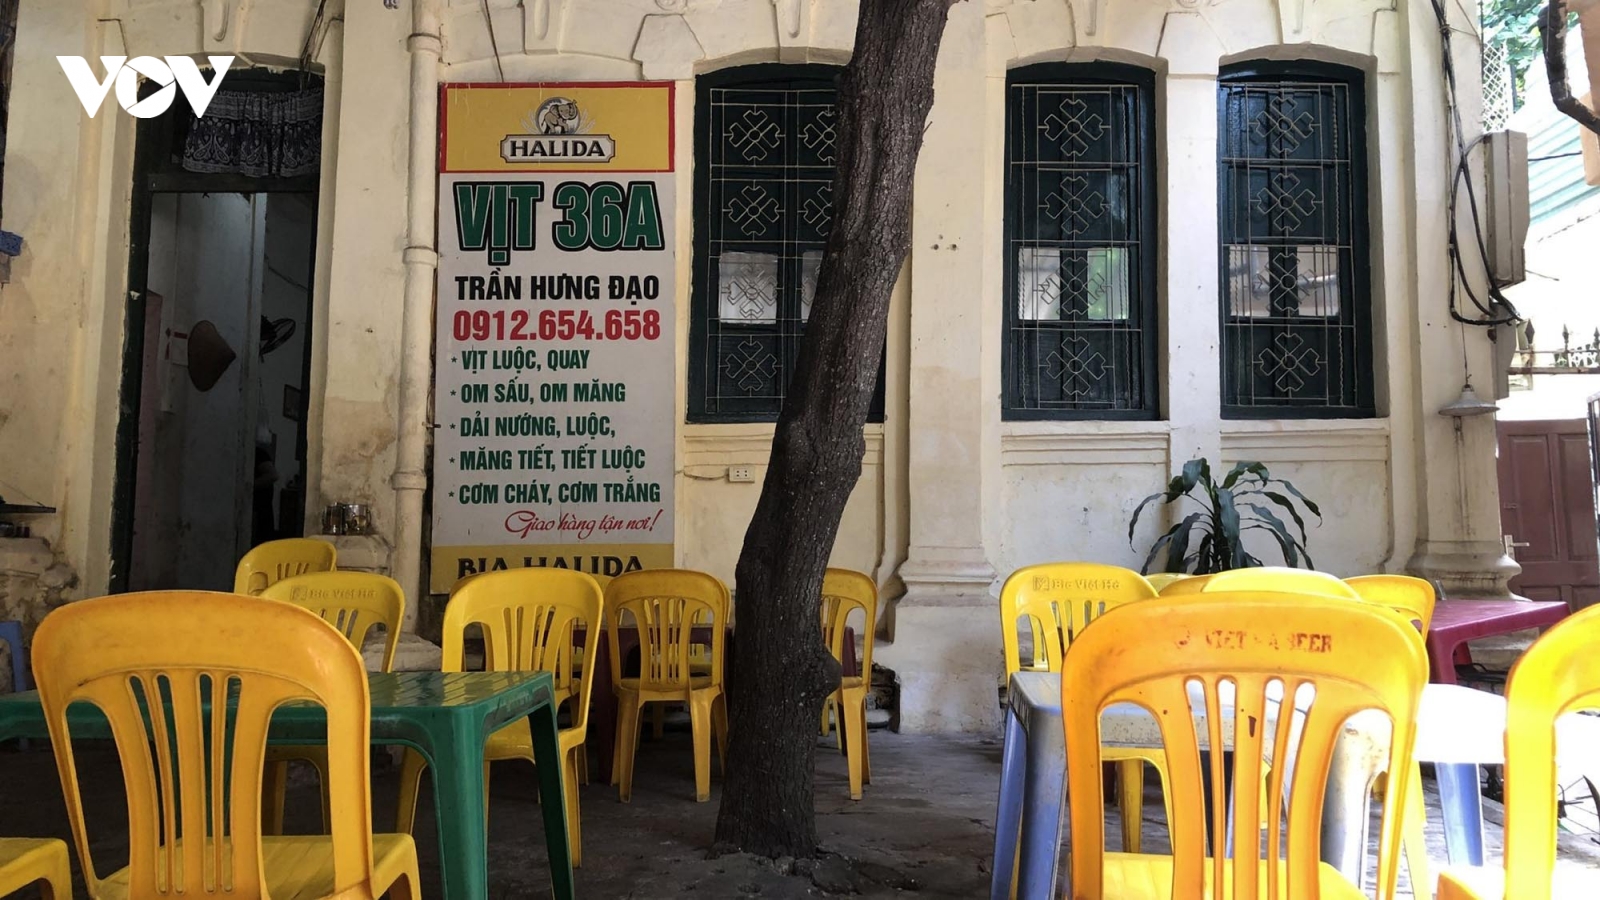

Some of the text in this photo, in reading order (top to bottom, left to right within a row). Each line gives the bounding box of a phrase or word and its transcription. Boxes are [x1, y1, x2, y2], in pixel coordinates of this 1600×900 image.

[509, 140, 606, 157] HALIDA
[453, 181, 665, 266] VỊT 36A
[455, 267, 659, 305] TRẦN HƯNG ĐẠO
[453, 310, 661, 341] 0912.654.658
[461, 346, 590, 374] VỊT LUỘC, QUAY
[461, 376, 626, 405] OM SẤU, OM MĂNG
[460, 411, 616, 440] DẢI NƯỚNG, LUỘC,
[460, 443, 646, 473] MĂNG TIẾT, TIẾT LUỘC
[459, 475, 661, 506] CƠM CHÁY, CƠM TRẮNG
[504, 509, 664, 540] Giao hàng tận nơi!
[457, 555, 644, 580] BIA HALIDA
